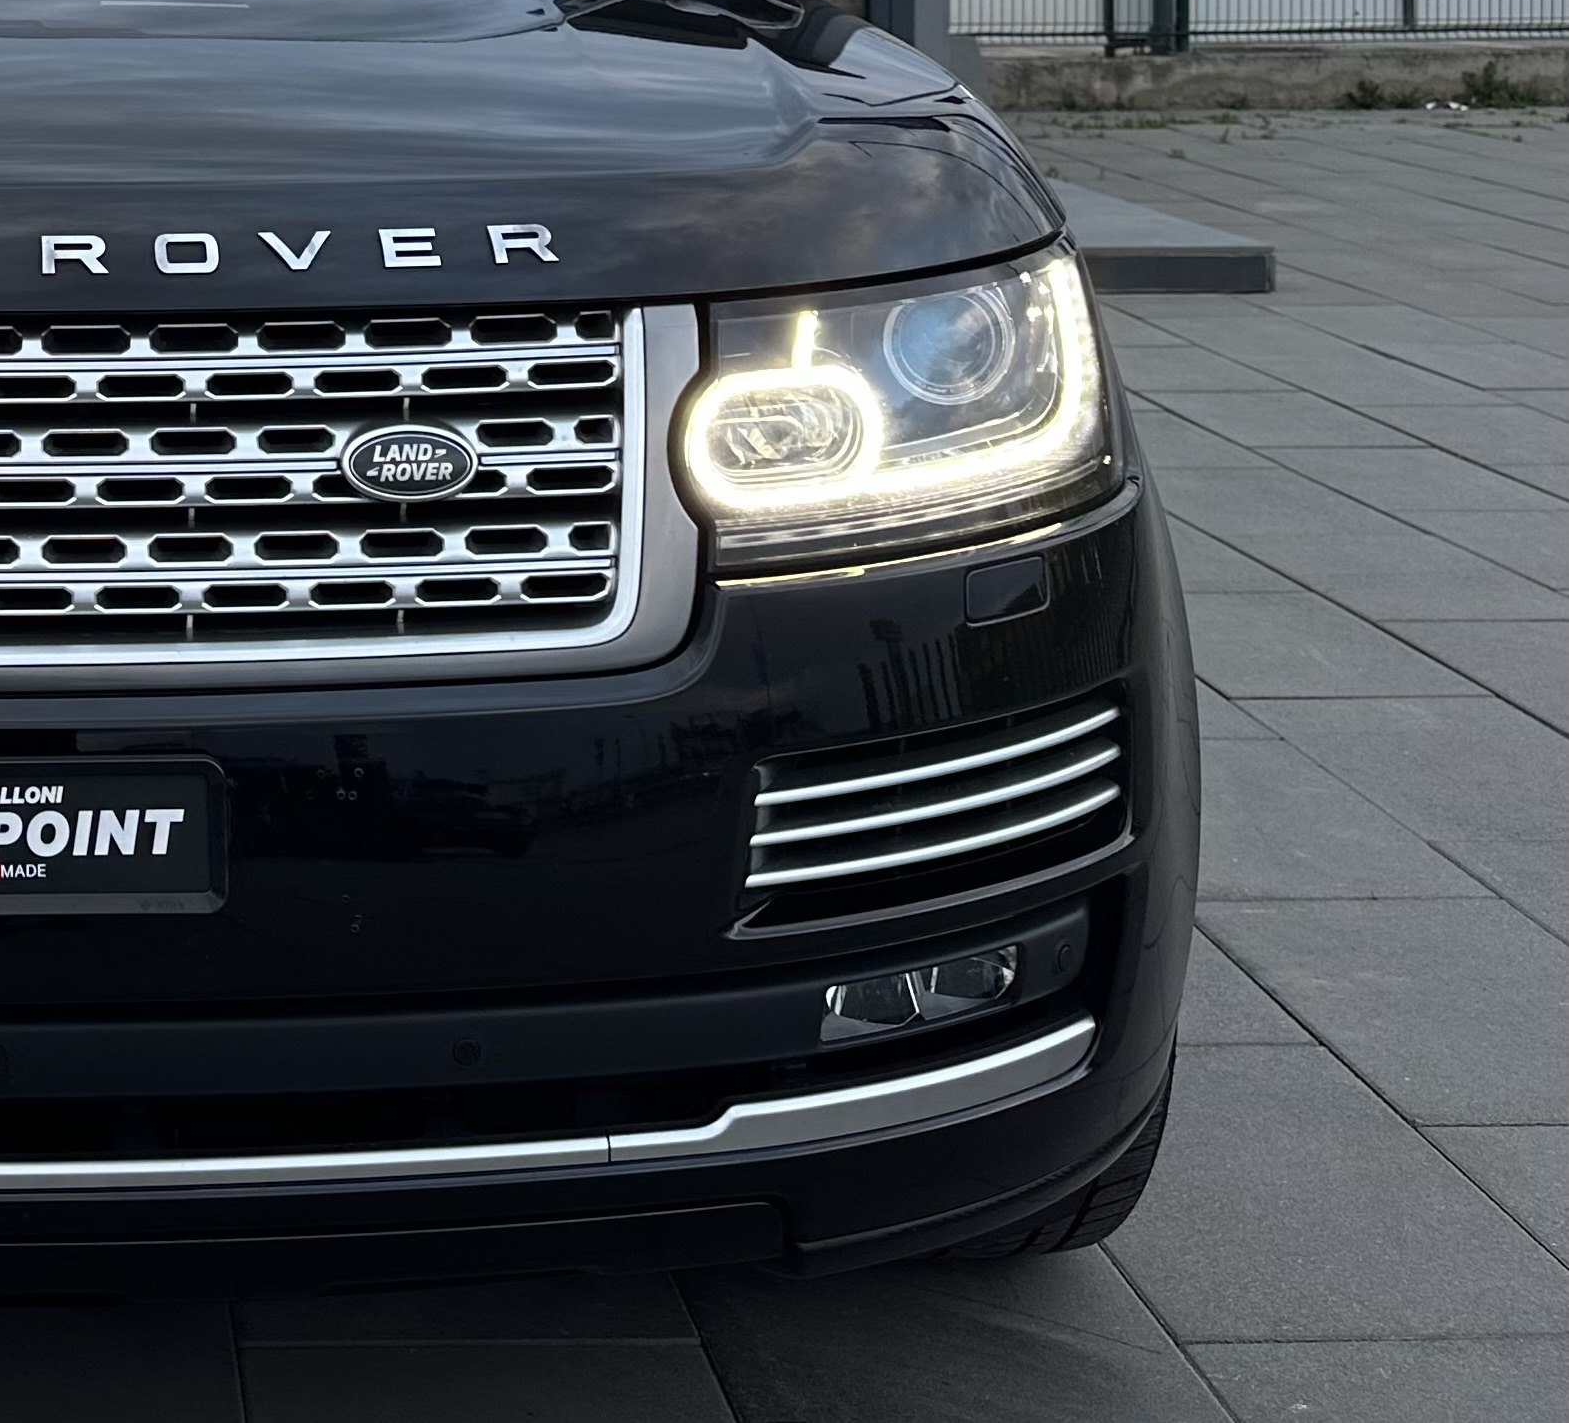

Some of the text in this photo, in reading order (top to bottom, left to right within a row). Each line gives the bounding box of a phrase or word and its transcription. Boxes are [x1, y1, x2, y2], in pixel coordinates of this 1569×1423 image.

[42, 223, 561, 275] ROVER
[373, 443, 453, 482] LAND ROVER
[0, 862, 47, 878] MADE
